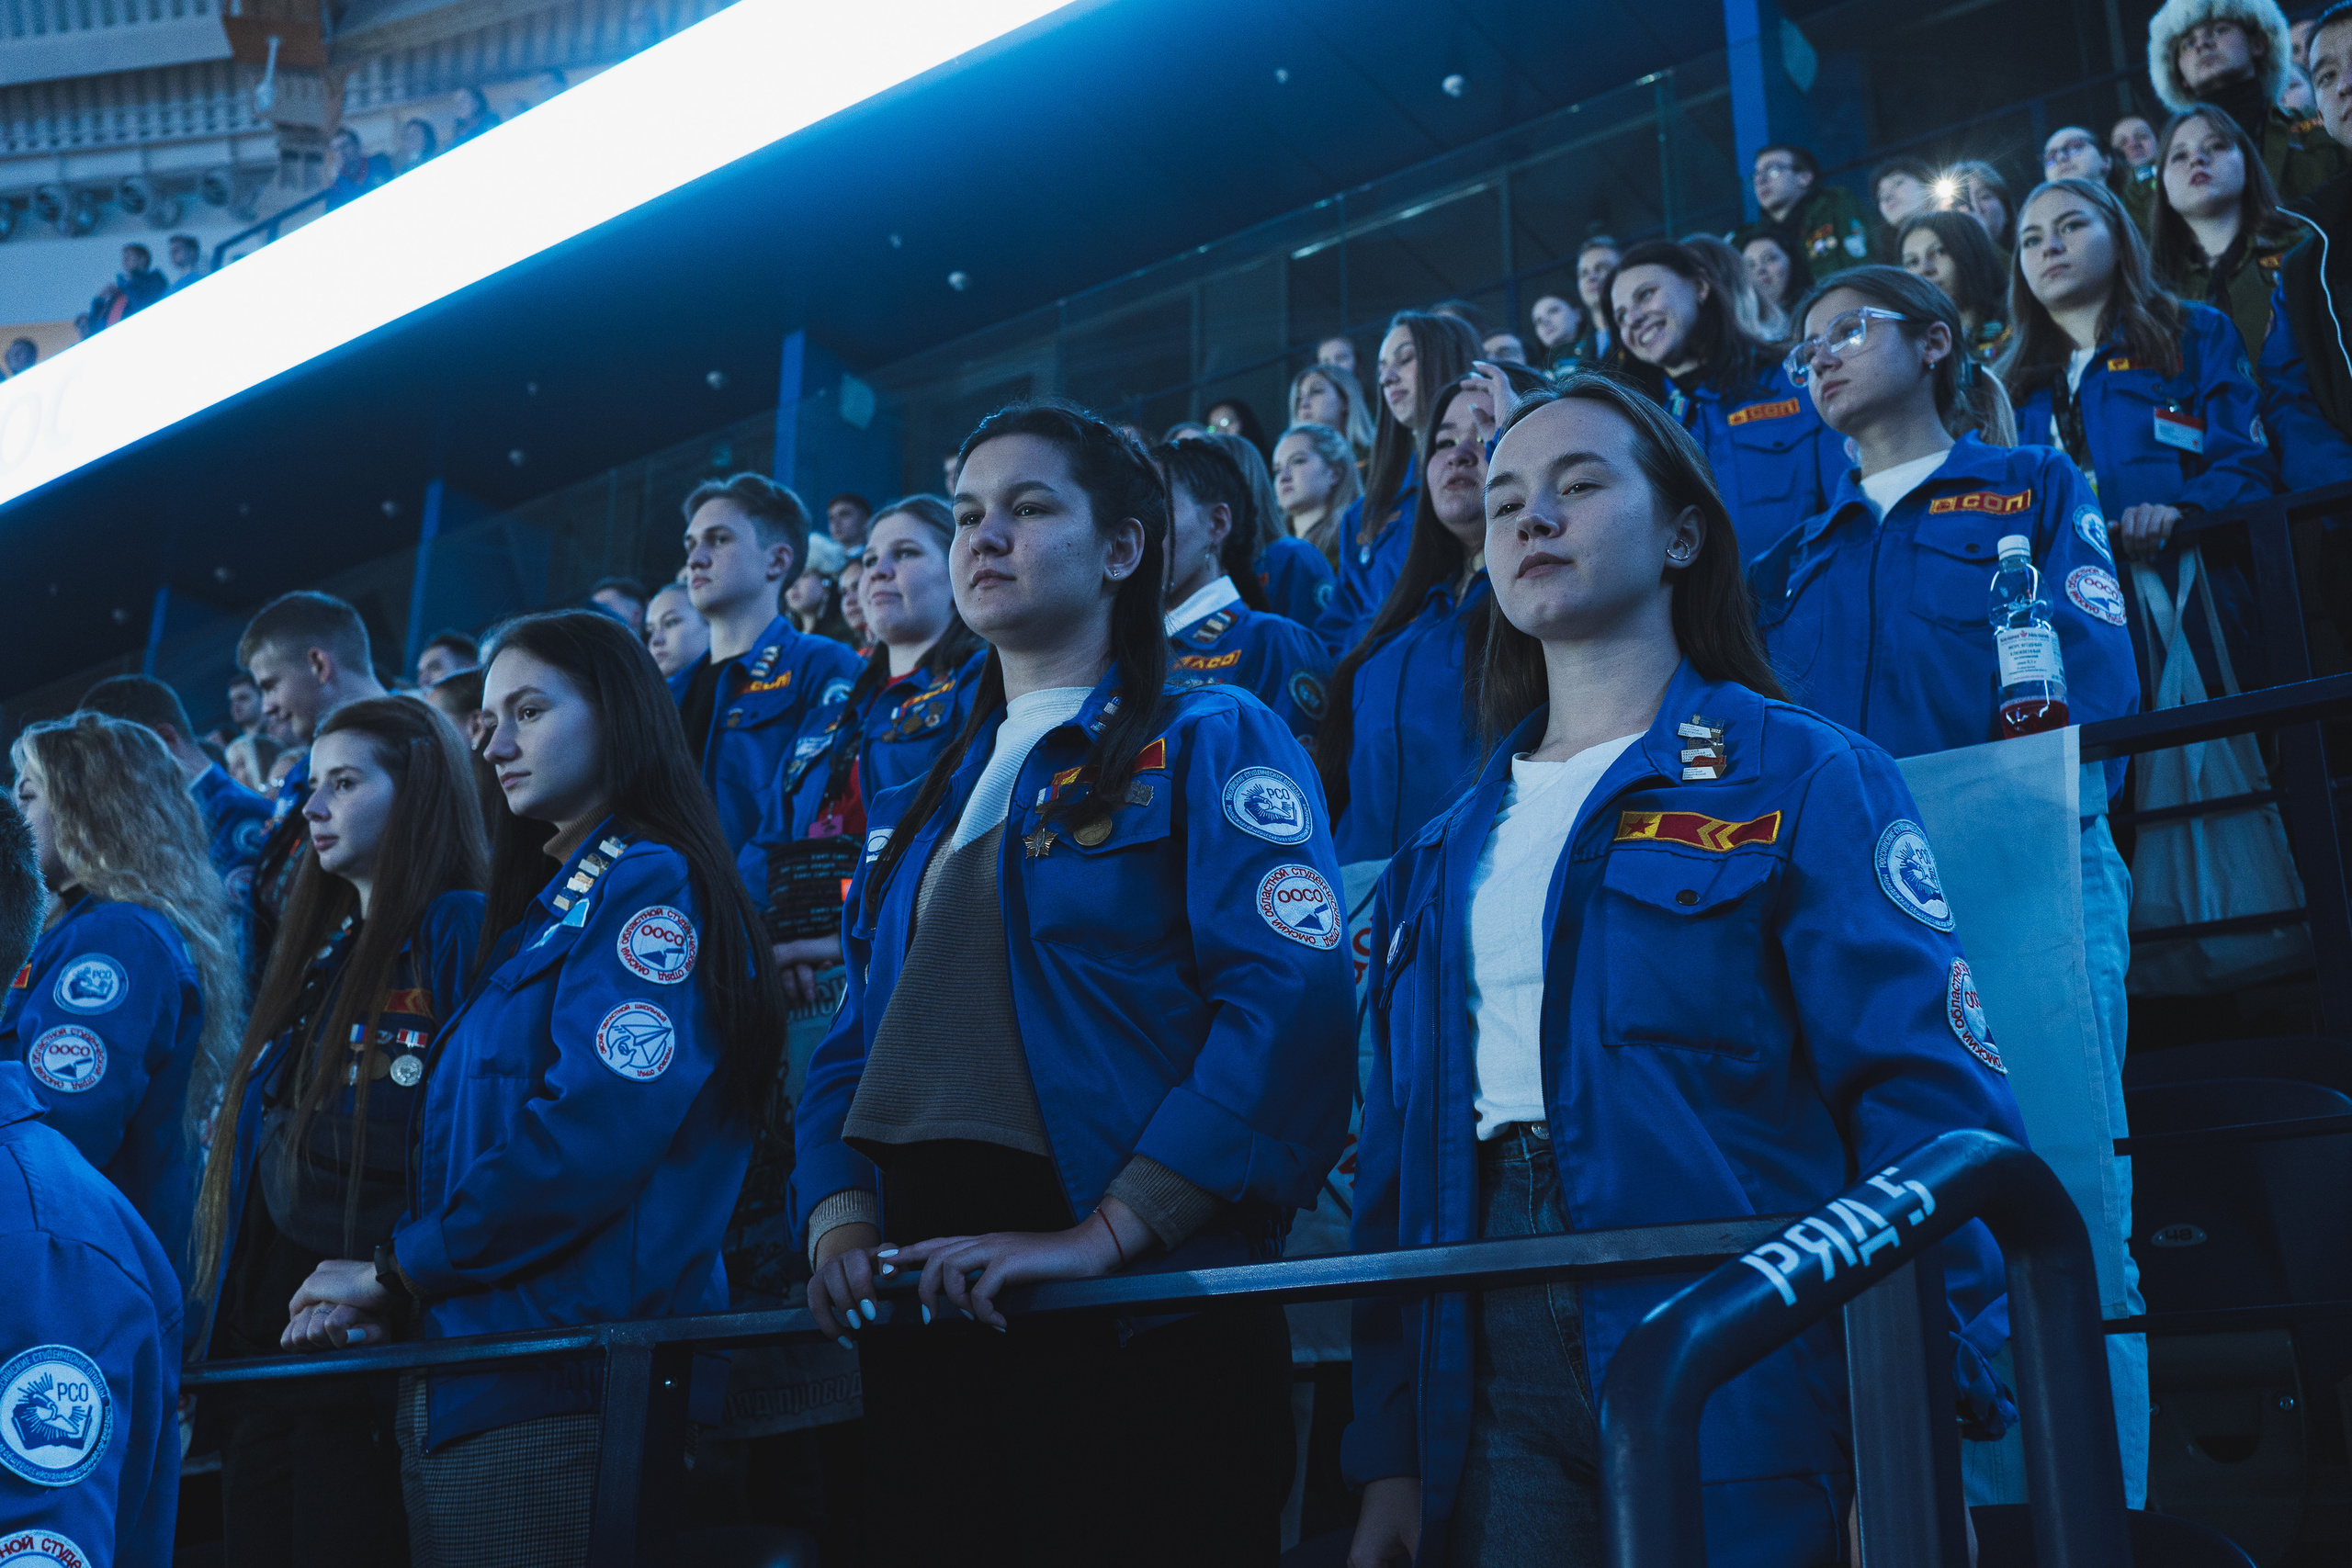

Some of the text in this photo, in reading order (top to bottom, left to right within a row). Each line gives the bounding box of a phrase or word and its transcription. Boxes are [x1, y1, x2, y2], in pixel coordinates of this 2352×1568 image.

[1962, 494, 2024, 511] СОП
[1266, 787, 1290, 800] РСО
[1277, 888, 1323, 903] ООСО
[641, 924, 685, 947] ООСО
[49, 1044, 90, 1056] ООСО
[1739, 1166, 1937, 1307] РЯД 5
[2165, 1227, 2193, 1242] 48
[32, 1349, 88, 1370] СТУДЕНЧЕСКИЕ
[86, 1366, 107, 1397] ОТРЯДЫ
[57, 1382, 89, 1403] РСО
